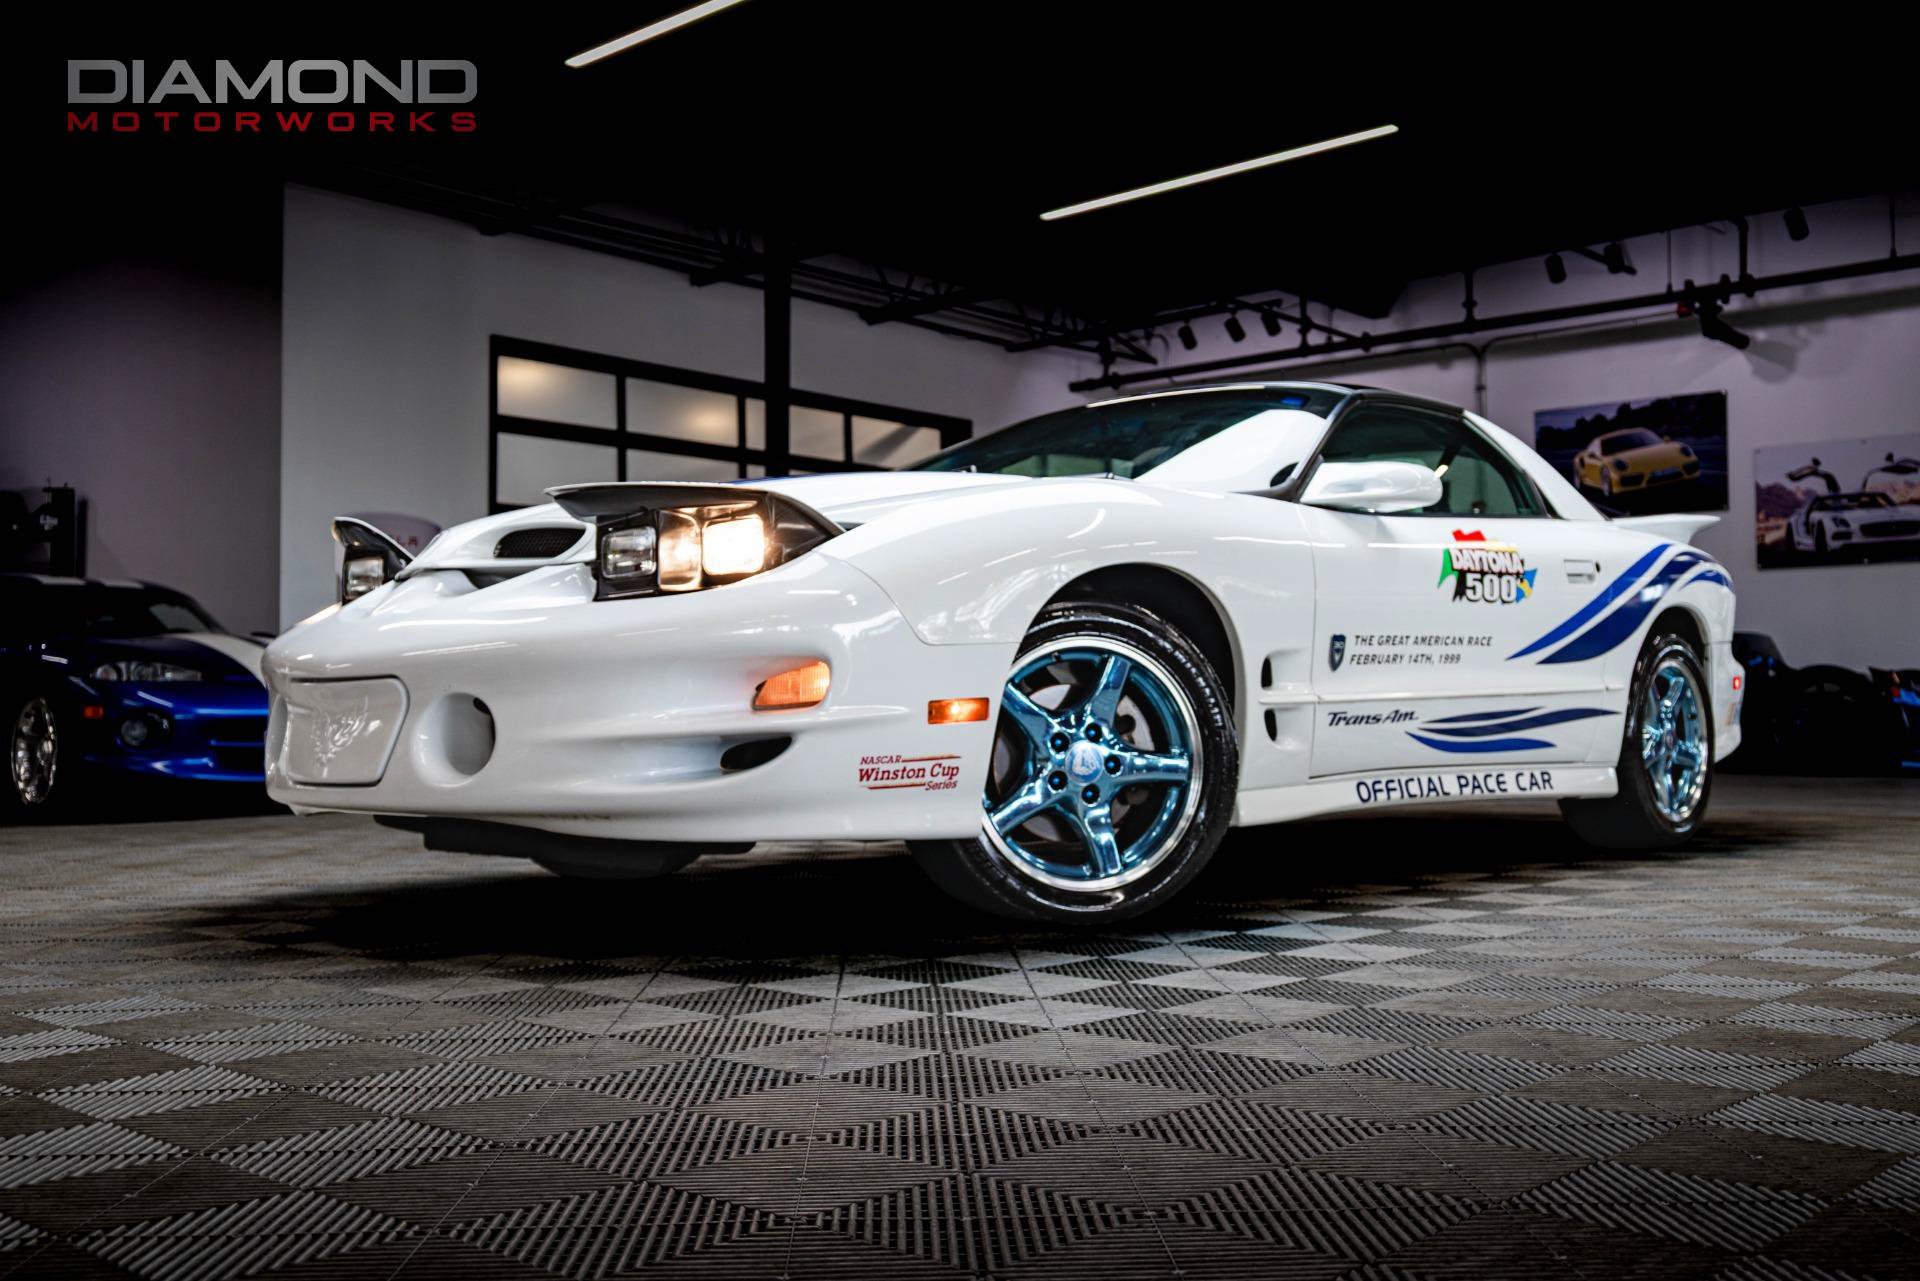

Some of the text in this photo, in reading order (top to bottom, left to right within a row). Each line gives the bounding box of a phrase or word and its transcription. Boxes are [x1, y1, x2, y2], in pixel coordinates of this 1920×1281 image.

[1450, 548, 1525, 574] DAYTONA
[1465, 573, 1517, 603] 500
[1354, 635, 1493, 647] THE GREAT AMERICAN RACE
[1350, 654, 1461, 665] FEBRUARY 14TH, 1999
[1328, 709, 1418, 726] Trans Am
[860, 755, 902, 765] NASCAR
[858, 763, 960, 782] Winston Cup
[925, 781, 957, 791] Series
[1356, 771, 1554, 803] OFFICIAL PACE CAR
